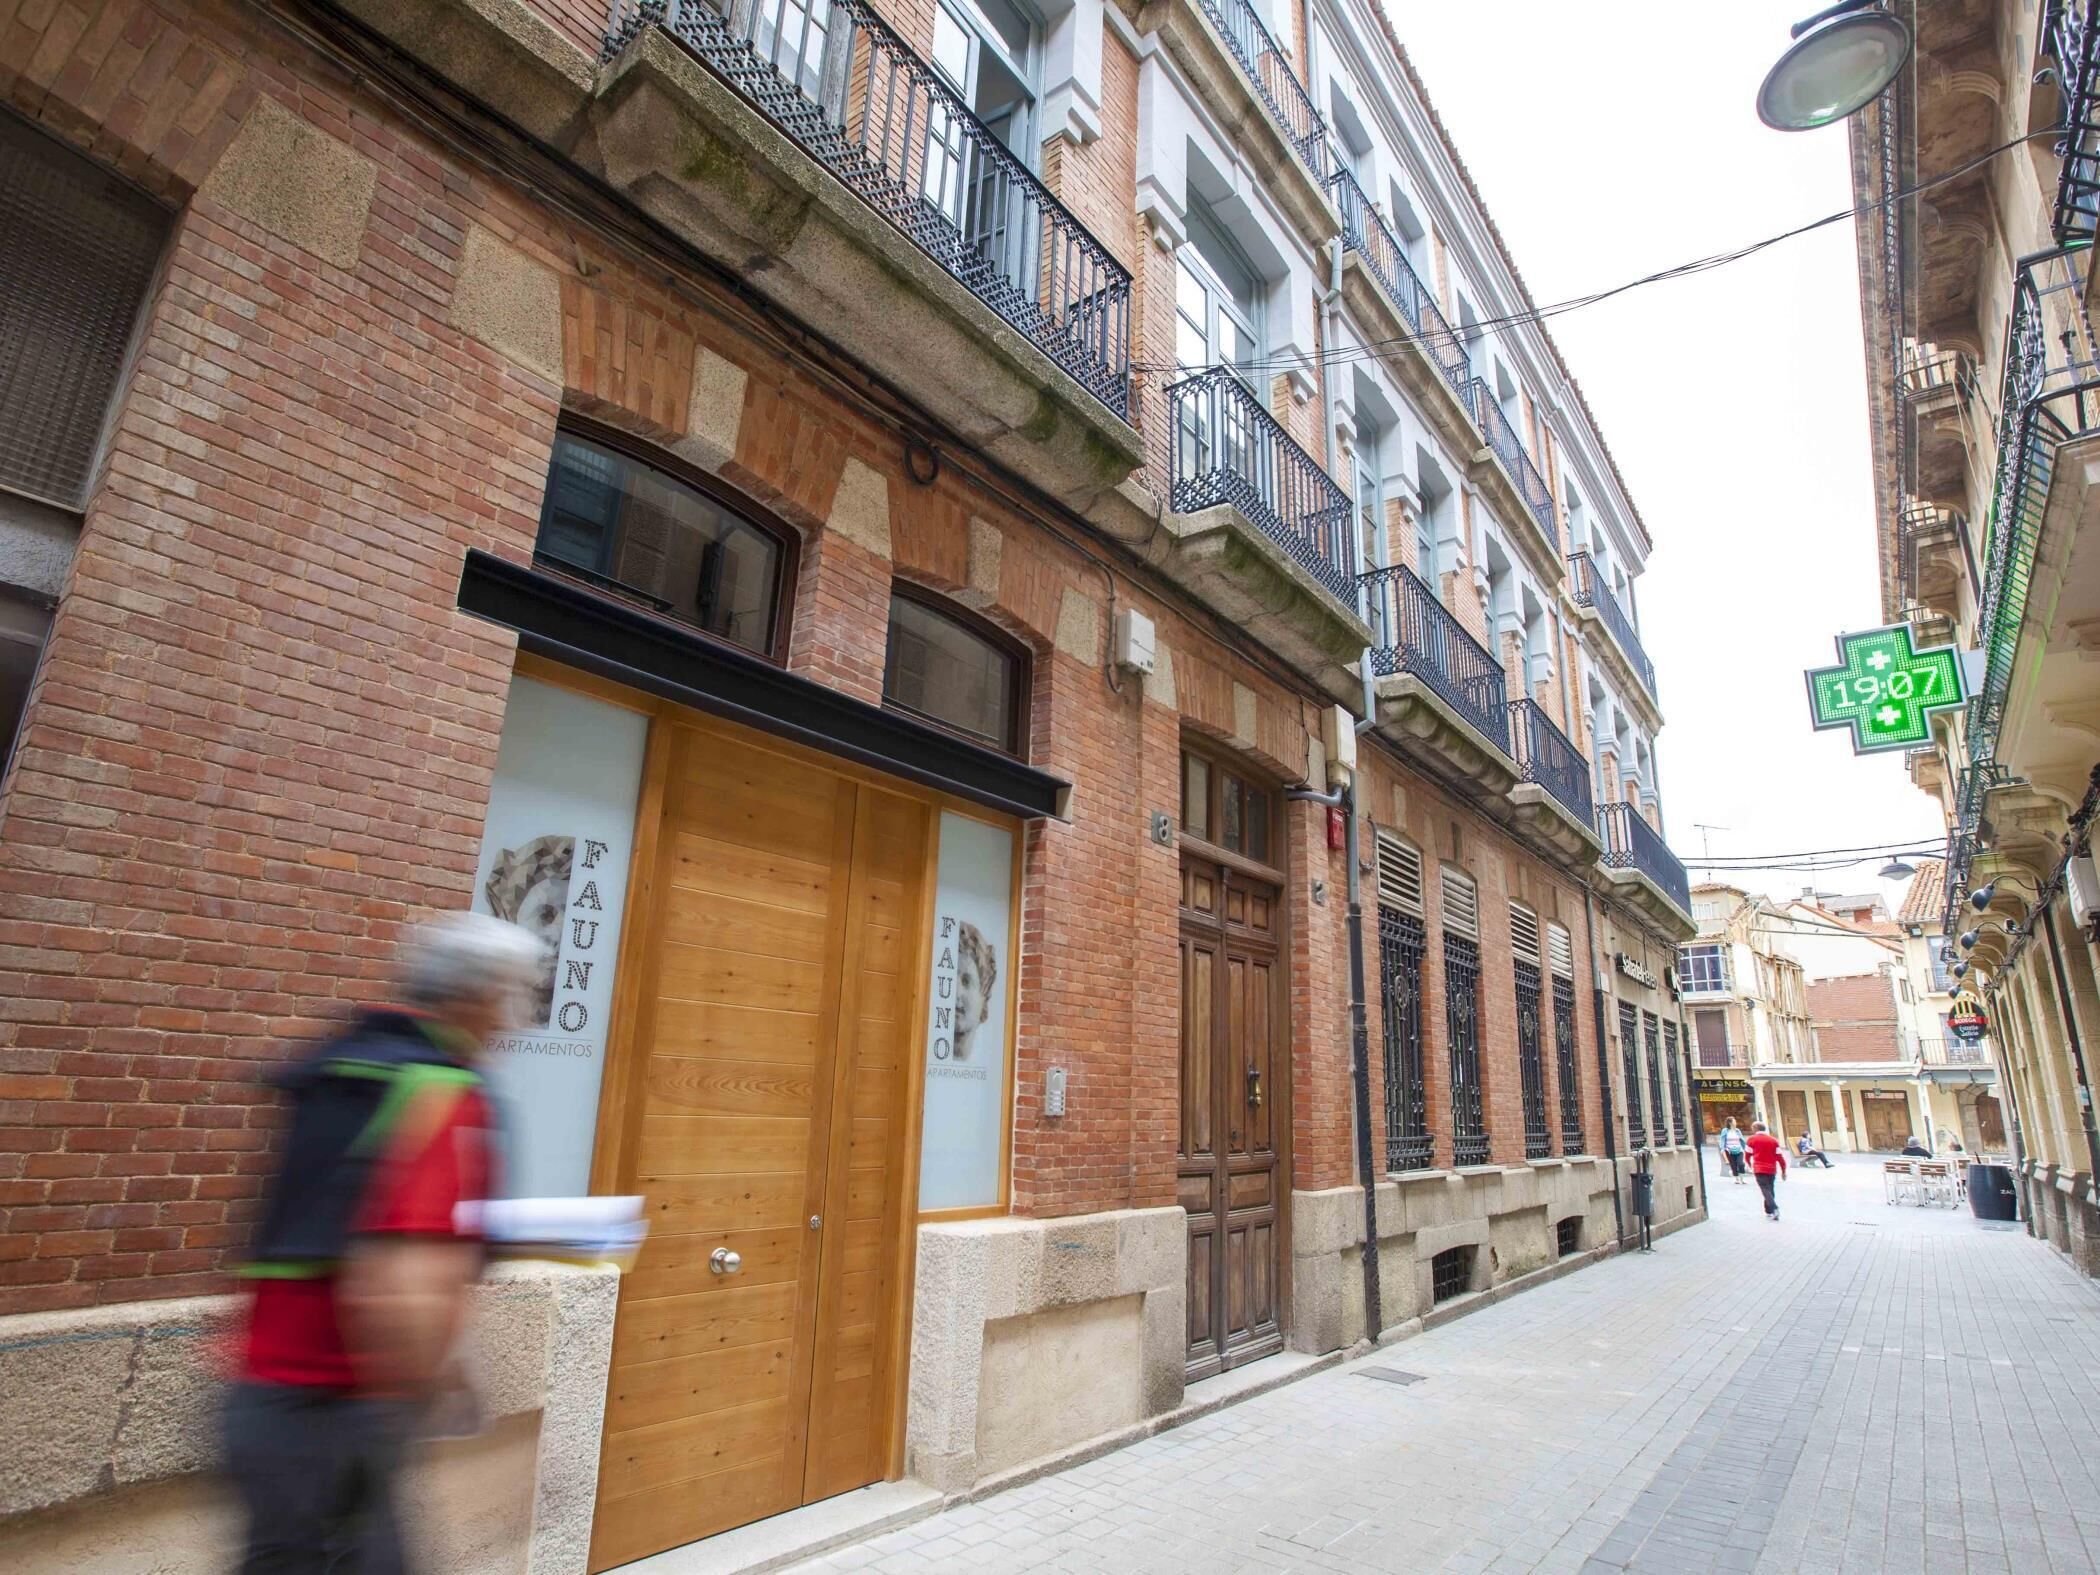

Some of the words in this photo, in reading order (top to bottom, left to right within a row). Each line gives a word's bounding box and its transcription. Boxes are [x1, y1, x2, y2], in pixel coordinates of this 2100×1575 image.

[1833, 666, 1939, 708] 19:07
[1159, 815, 1169, 841] 8
[558, 839, 609, 1033] FAUNO
[933, 916, 956, 1061] FAUNO
[486, 1038, 593, 1058] PARTAMENTOS
[927, 1067, 988, 1081] APARTAMENTOS
[1701, 1080, 1748, 1088] ALONSO
